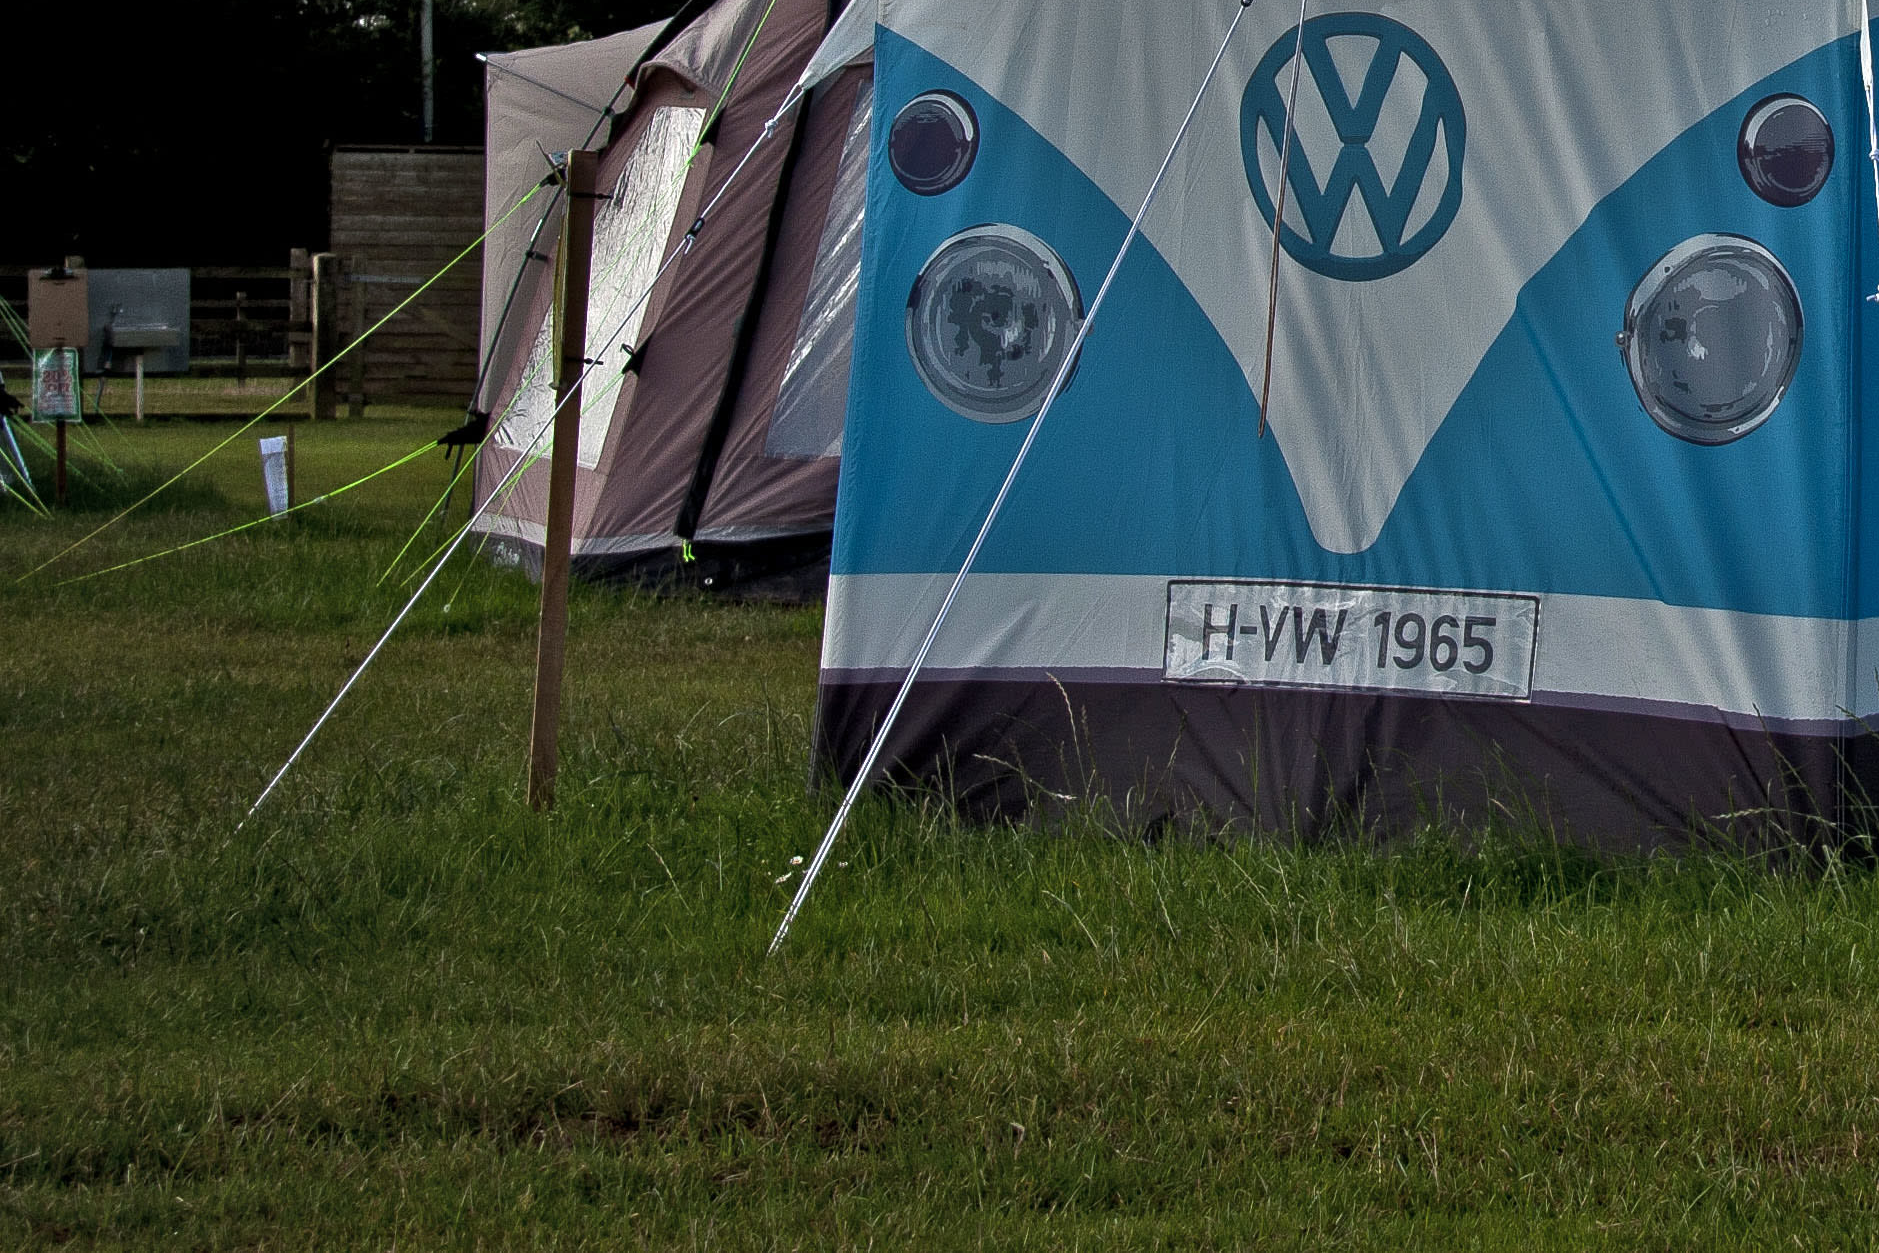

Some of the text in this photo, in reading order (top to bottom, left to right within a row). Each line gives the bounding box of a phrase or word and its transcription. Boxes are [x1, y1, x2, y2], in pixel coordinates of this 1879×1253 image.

[1247, 17, 1460, 271] VW
[1201, 603, 1497, 675] H-VW 1965
